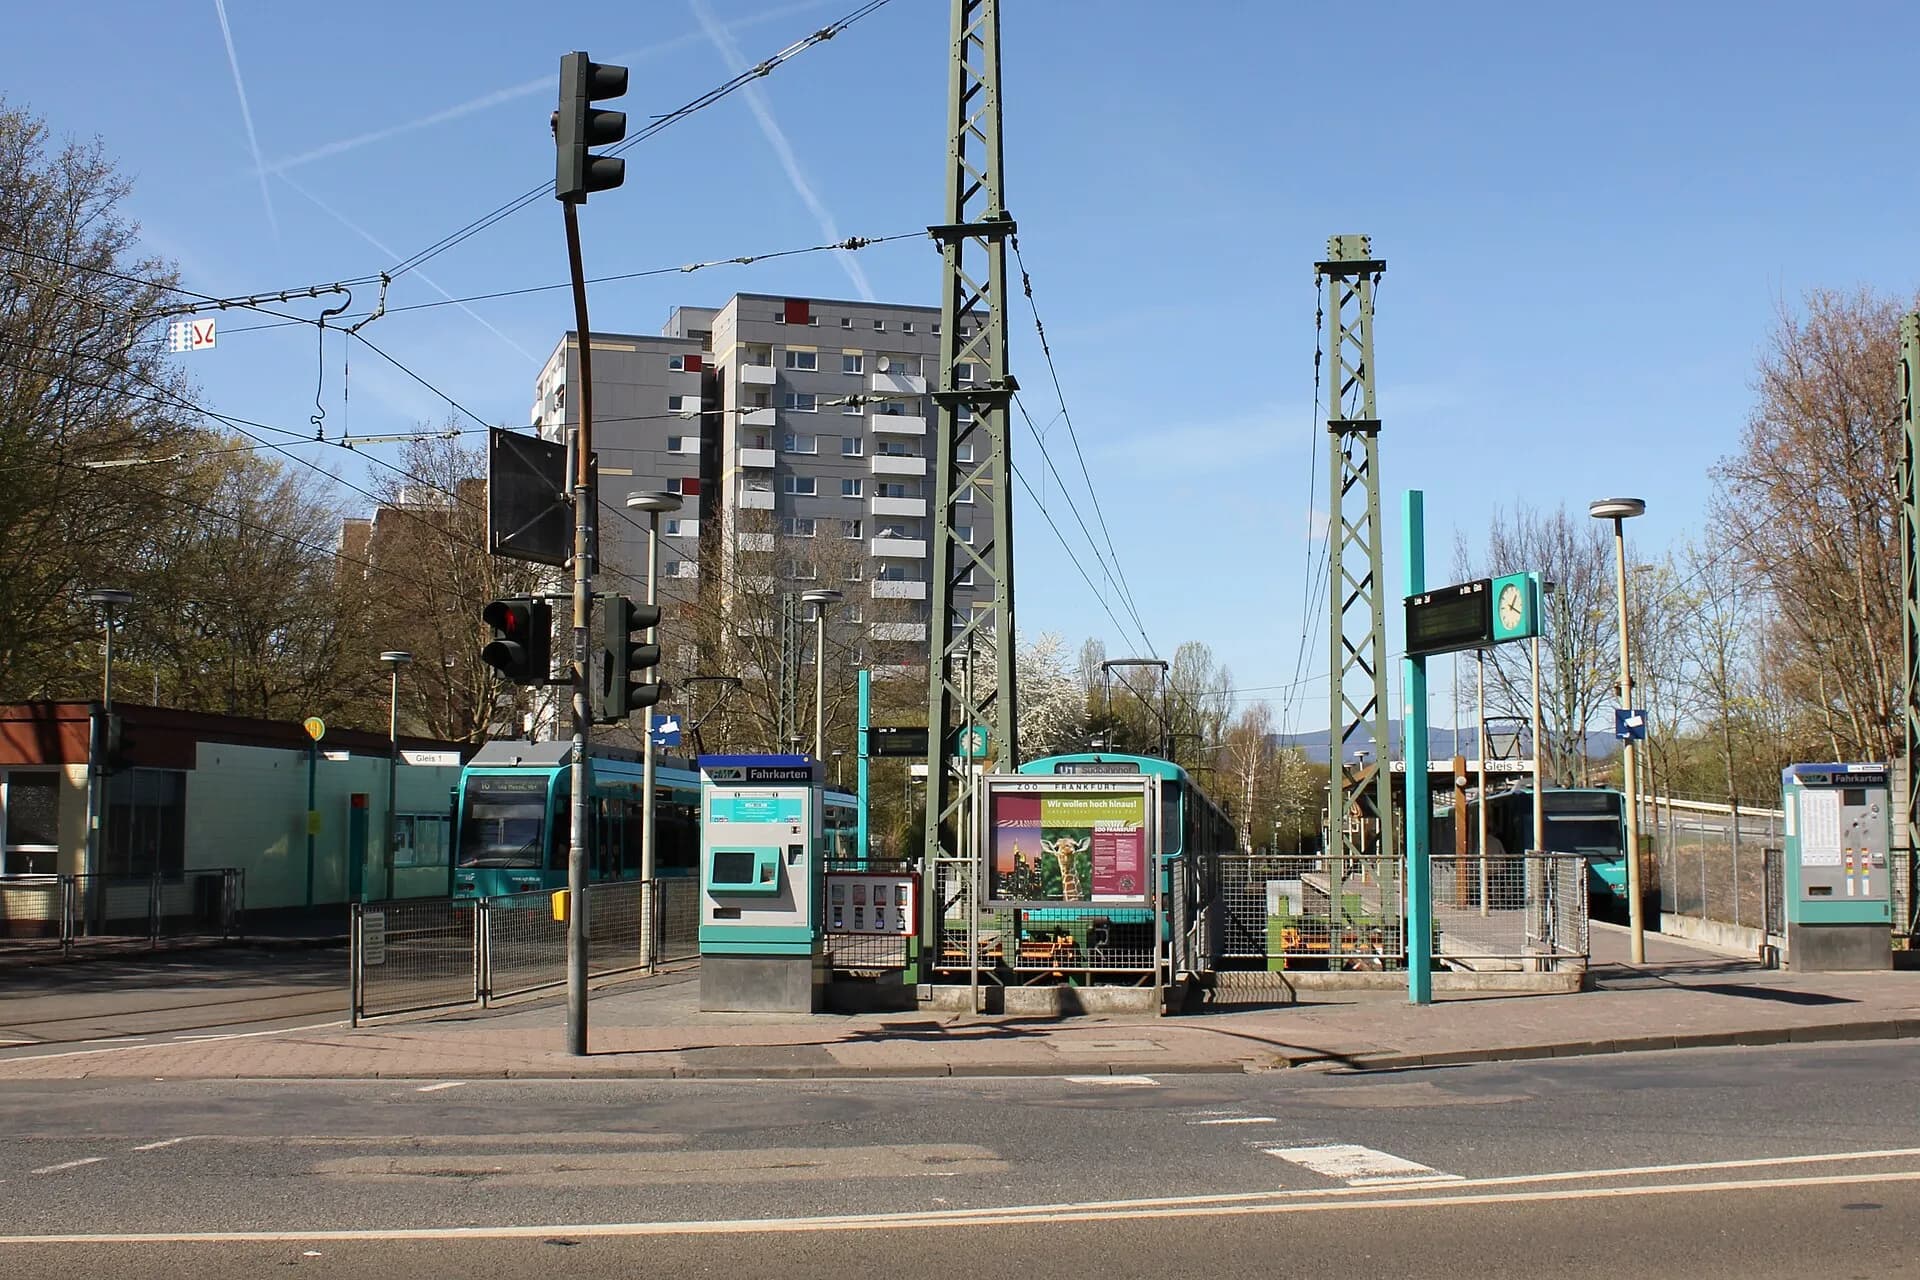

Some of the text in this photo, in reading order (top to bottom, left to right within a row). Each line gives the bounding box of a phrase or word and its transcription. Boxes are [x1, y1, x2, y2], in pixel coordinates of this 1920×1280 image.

[416, 754, 443, 762] Gleis 1
[1484, 761, 1525, 771] Gleis 5
[750, 768, 808, 779] Fahrkarten
[1835, 774, 1884, 783] Fahrkarten
[1017, 783, 1118, 791] ZOO FRANKFURT
[1047, 799, 1137, 808] Wir wollen hoch hinaus!
